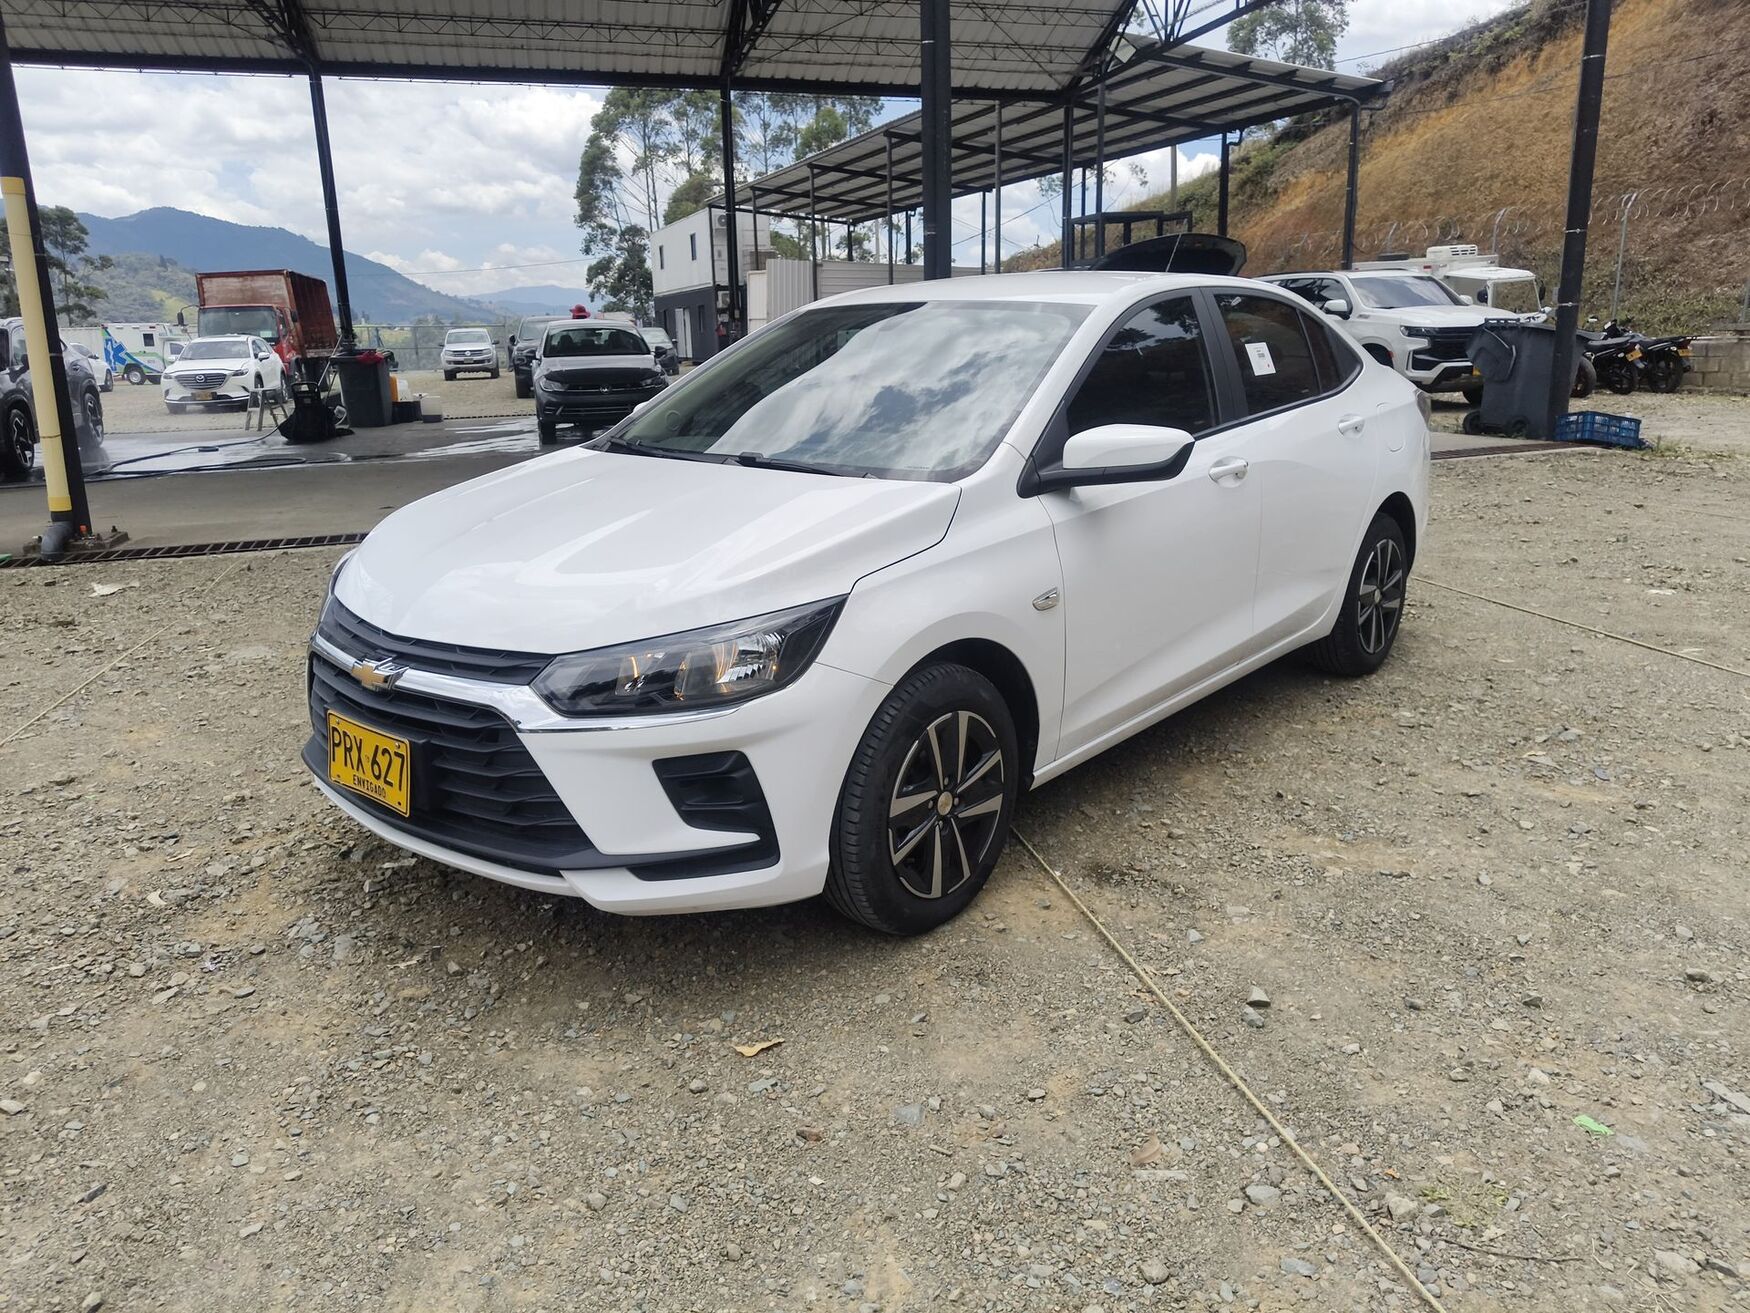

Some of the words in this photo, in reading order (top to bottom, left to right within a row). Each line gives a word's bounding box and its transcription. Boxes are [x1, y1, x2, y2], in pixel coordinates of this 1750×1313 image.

[331, 727, 366, 775] PRX
[371, 744, 405, 792] 627
[352, 774, 387, 798] ENVIGADO
